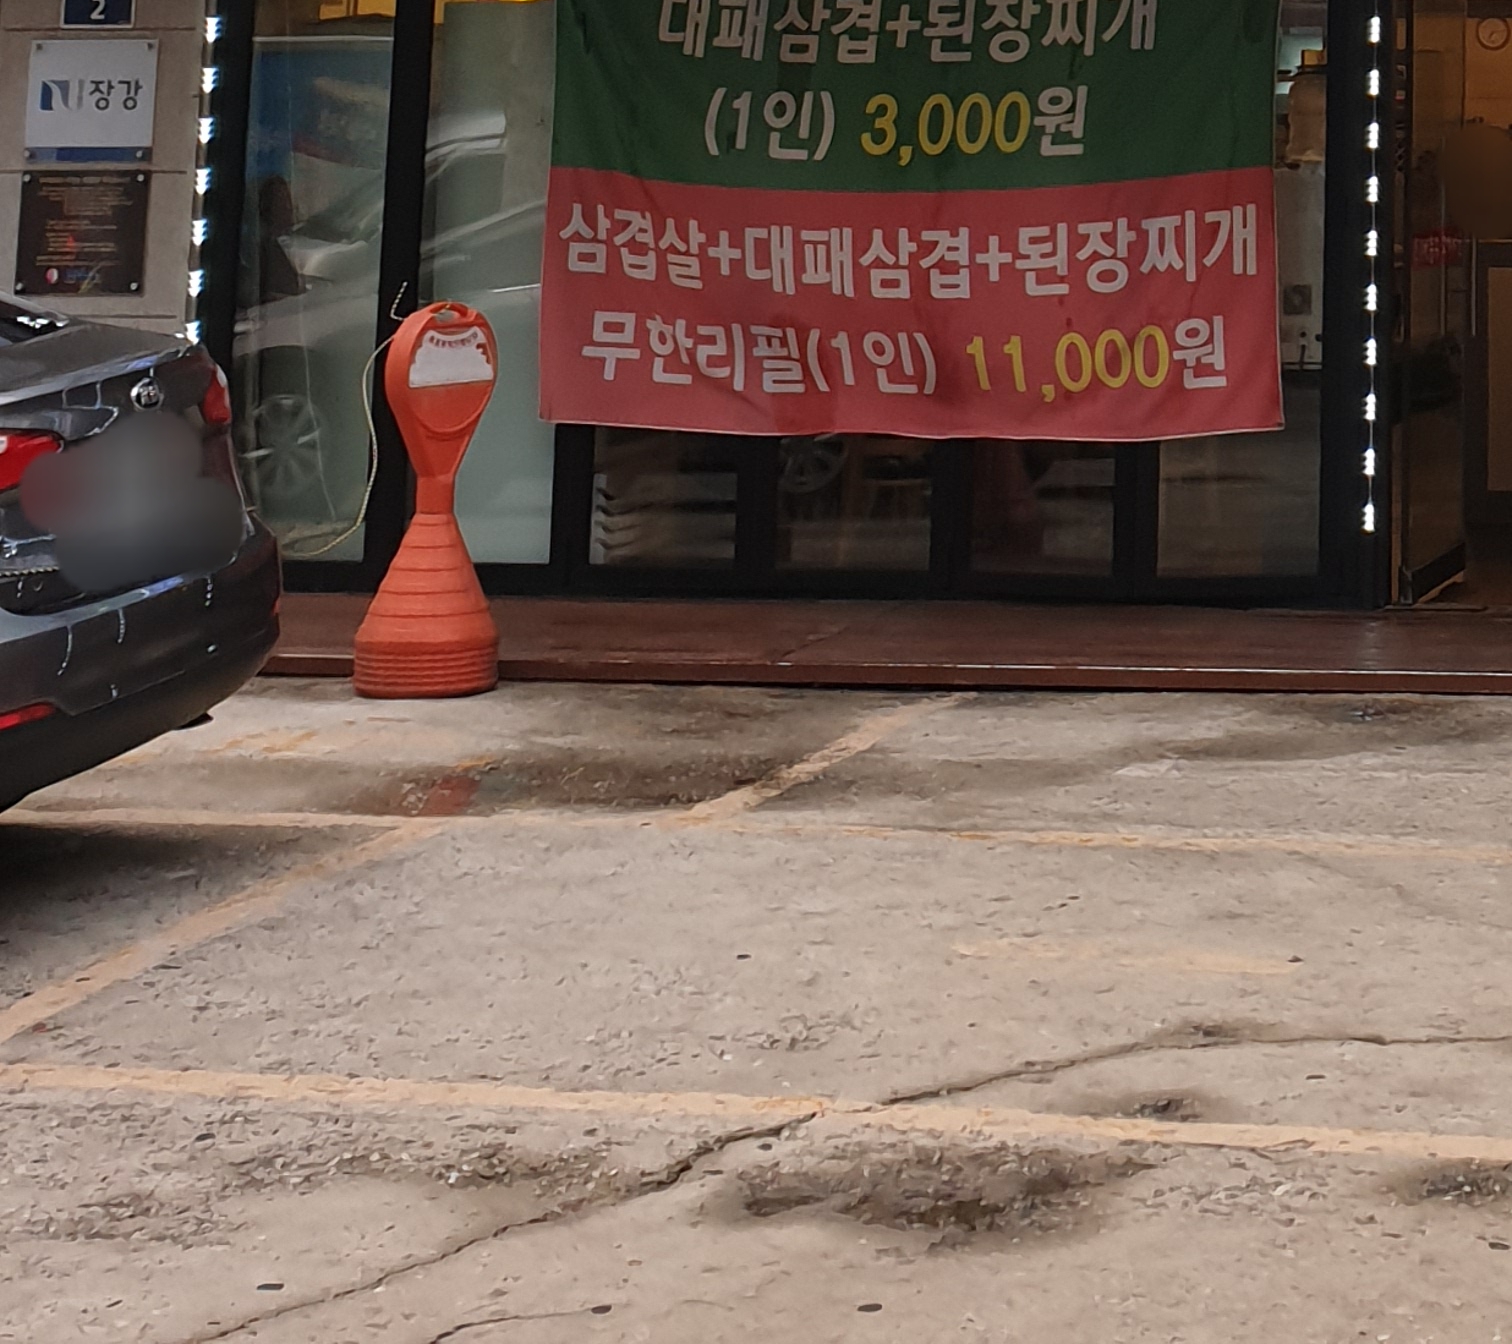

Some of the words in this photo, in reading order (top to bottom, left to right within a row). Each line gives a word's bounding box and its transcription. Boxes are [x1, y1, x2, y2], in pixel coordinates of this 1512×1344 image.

[88, 79, 143, 111] 장강
[704, 86, 835, 161] (1인)
[860, 85, 1088, 166] 3,000원
[559, 202, 1258, 300] 삼겹살+대패삼겹+된장찌개
[581, 311, 936, 396] 무한리필(1인)
[966, 315, 1227, 402] 11,000원
